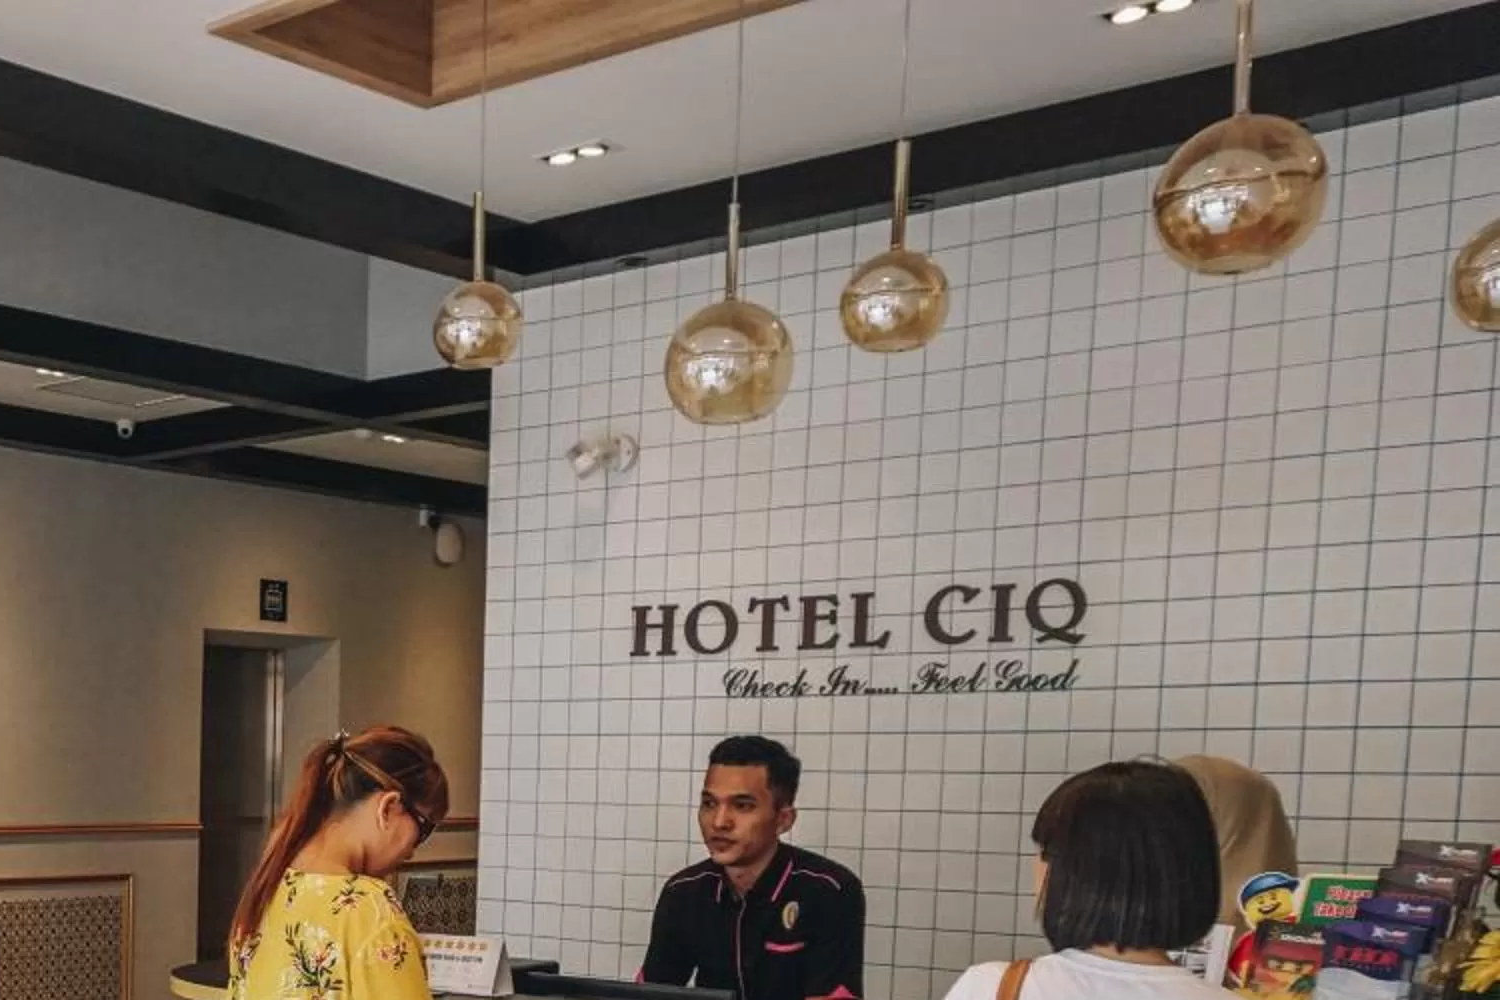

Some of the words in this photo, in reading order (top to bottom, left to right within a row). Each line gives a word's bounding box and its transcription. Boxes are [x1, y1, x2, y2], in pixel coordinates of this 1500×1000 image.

[629, 591, 891, 657] HOTEL
[923, 577, 1088, 645] CIQ
[722, 667, 811, 698] Check
[911, 661, 986, 693] Feel
[994, 657, 1081, 692] Good
